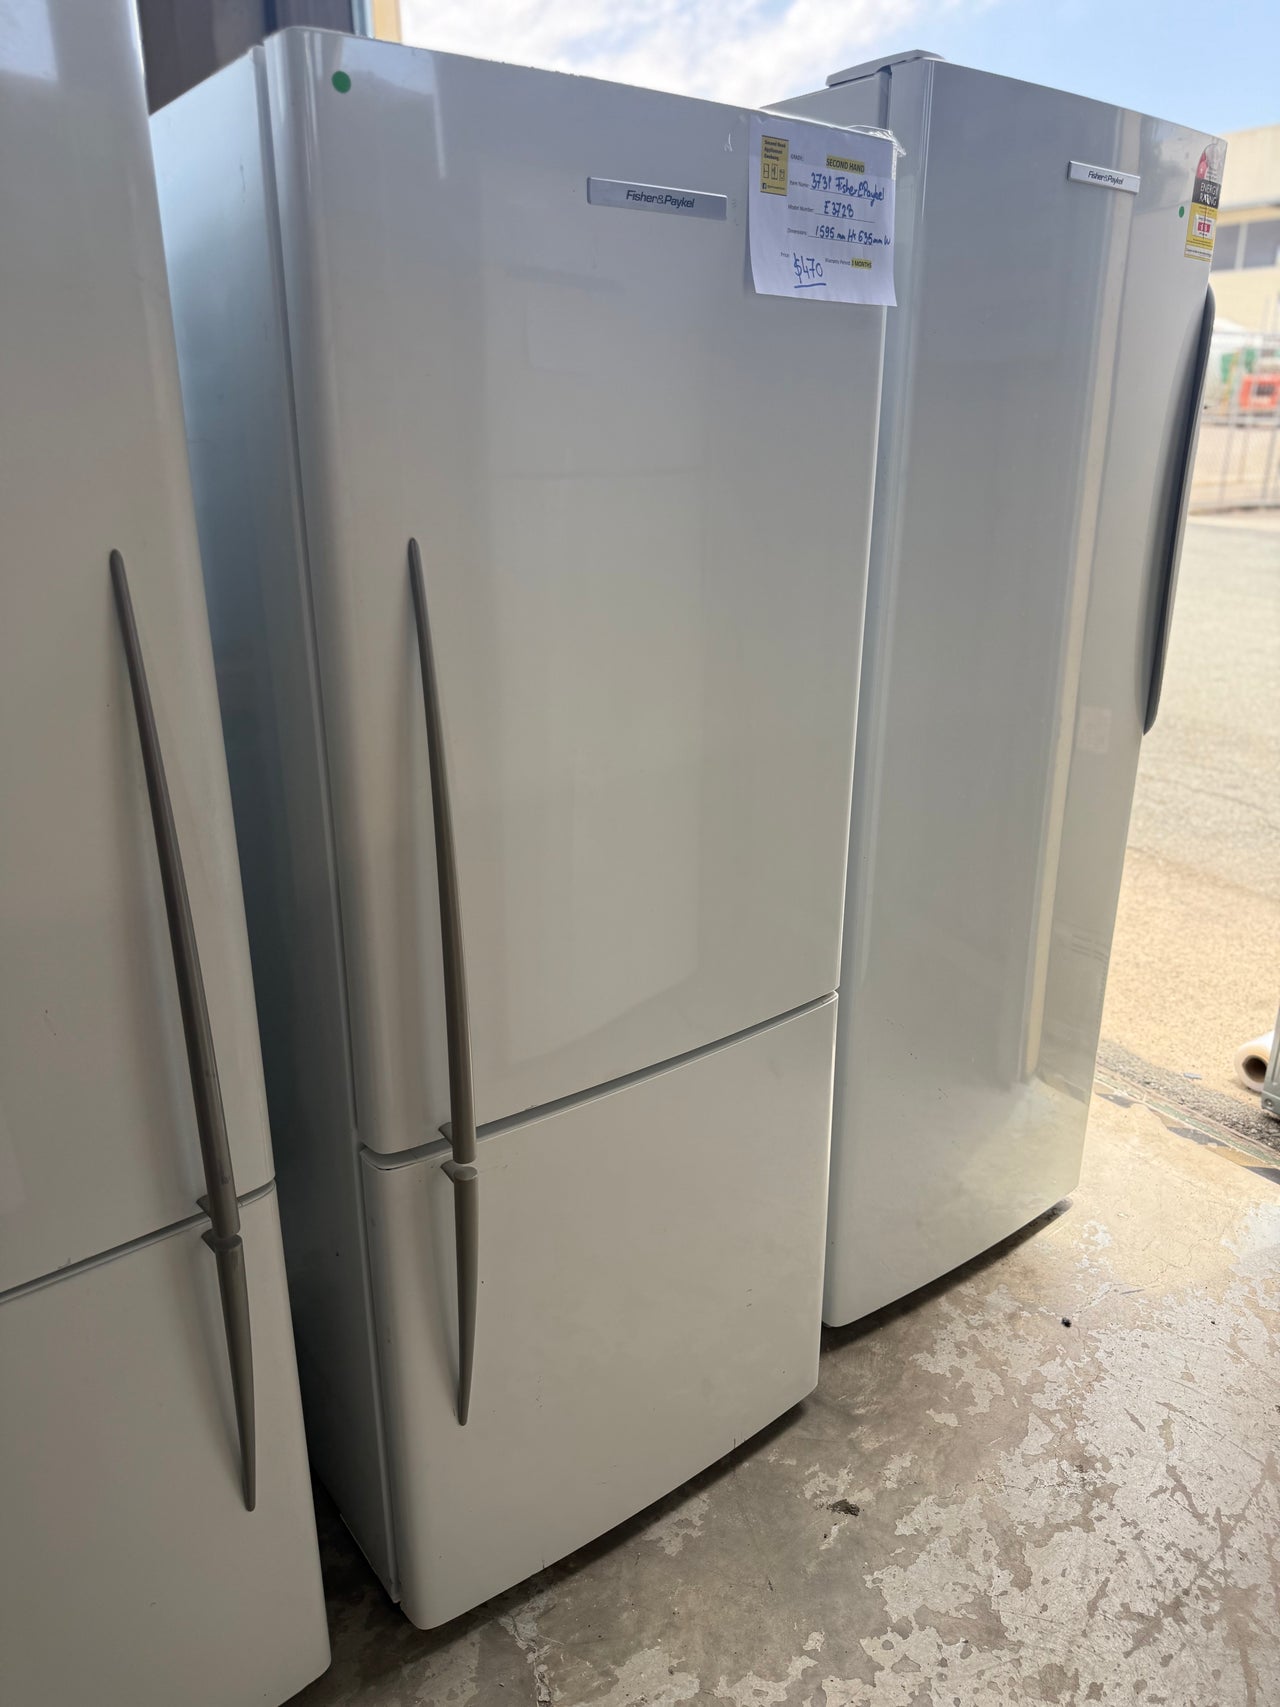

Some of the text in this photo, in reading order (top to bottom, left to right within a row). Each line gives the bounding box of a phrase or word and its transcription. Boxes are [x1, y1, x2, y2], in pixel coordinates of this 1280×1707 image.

[826, 158, 848, 169] SECOND
[849, 162, 865, 173] HAND
[1087, 170, 1124, 185] Fisher&Paykel
[626, 189, 695, 209] Fisher&Paykel
[793, 252, 823, 284] $470
[854, 260, 872, 269] MONTHS
